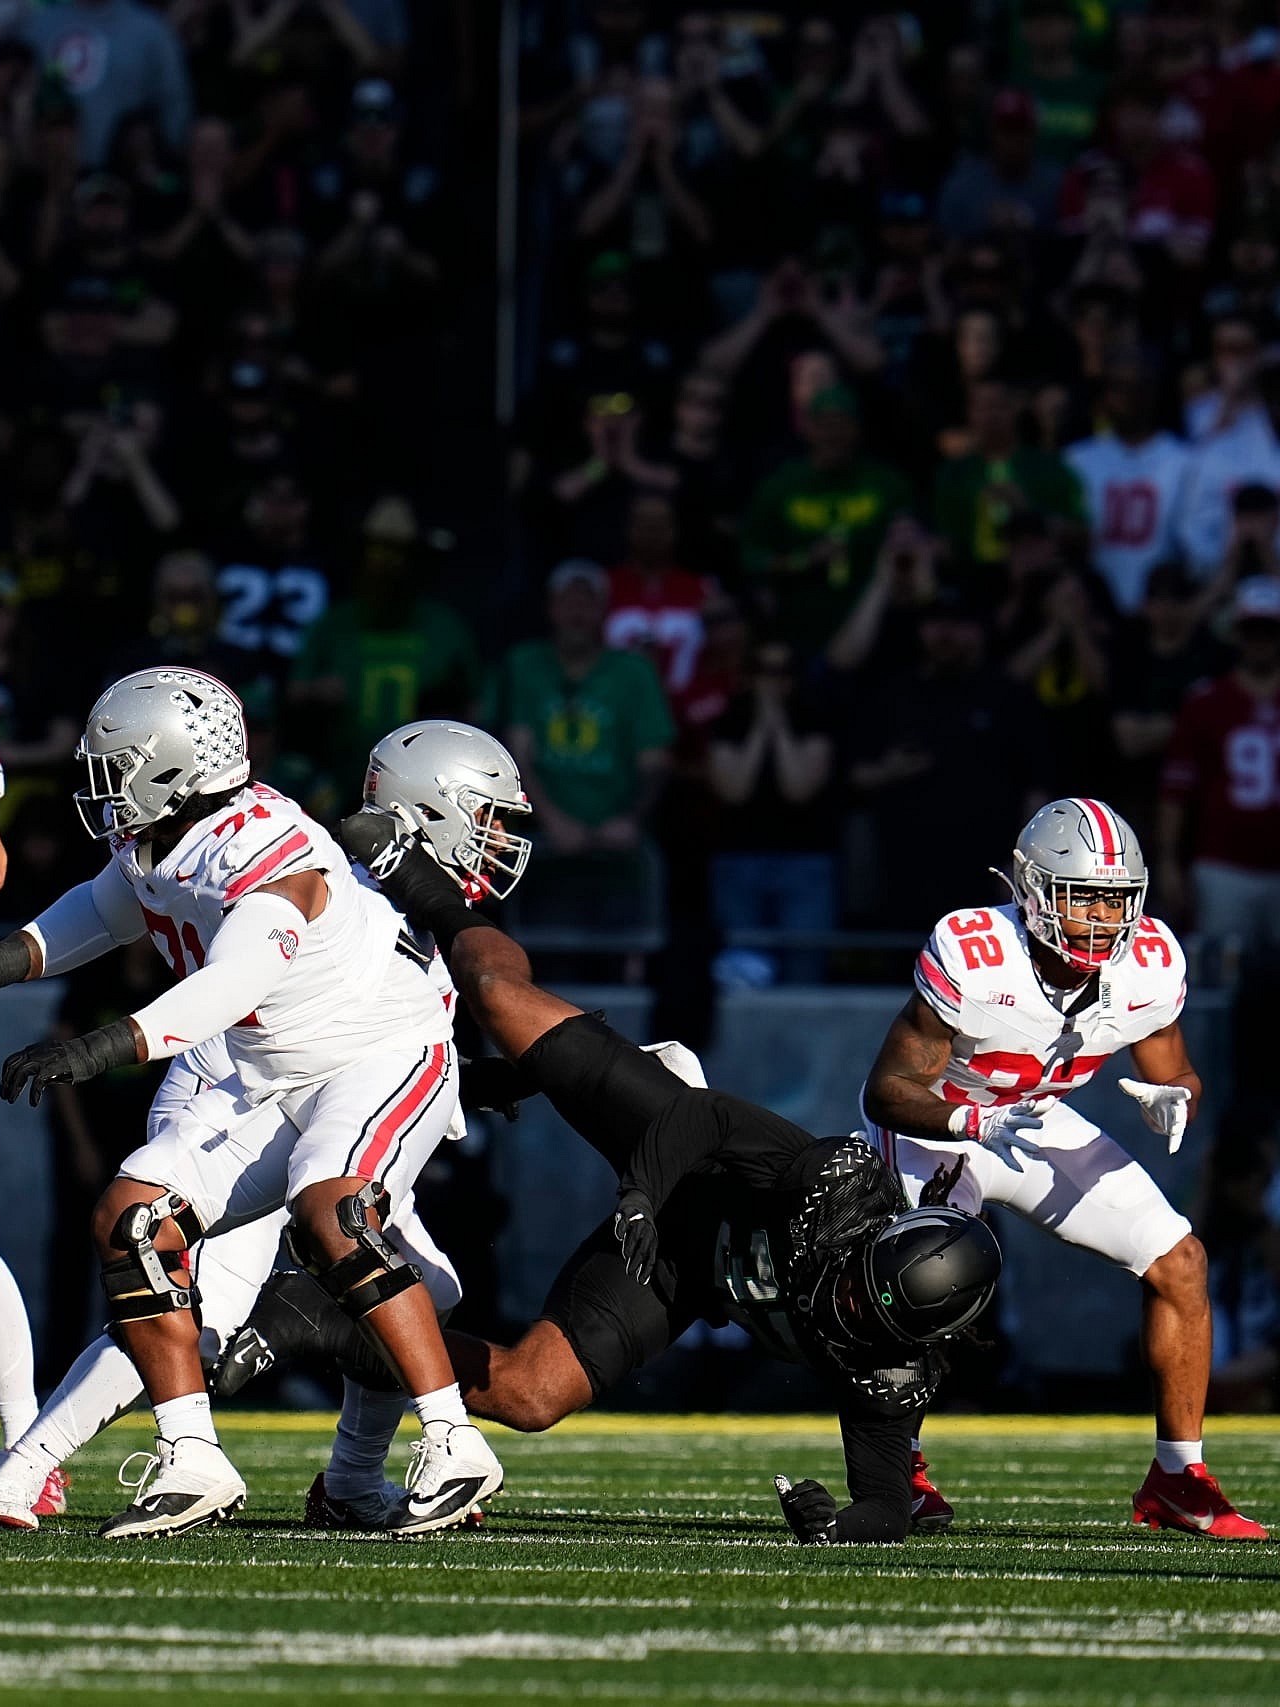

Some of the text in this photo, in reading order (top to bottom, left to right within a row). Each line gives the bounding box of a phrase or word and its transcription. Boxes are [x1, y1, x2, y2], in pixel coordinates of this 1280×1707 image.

[1104, 477, 1159, 546] 10
[218, 562, 331, 657] 23
[947, 910, 1004, 971] 32
